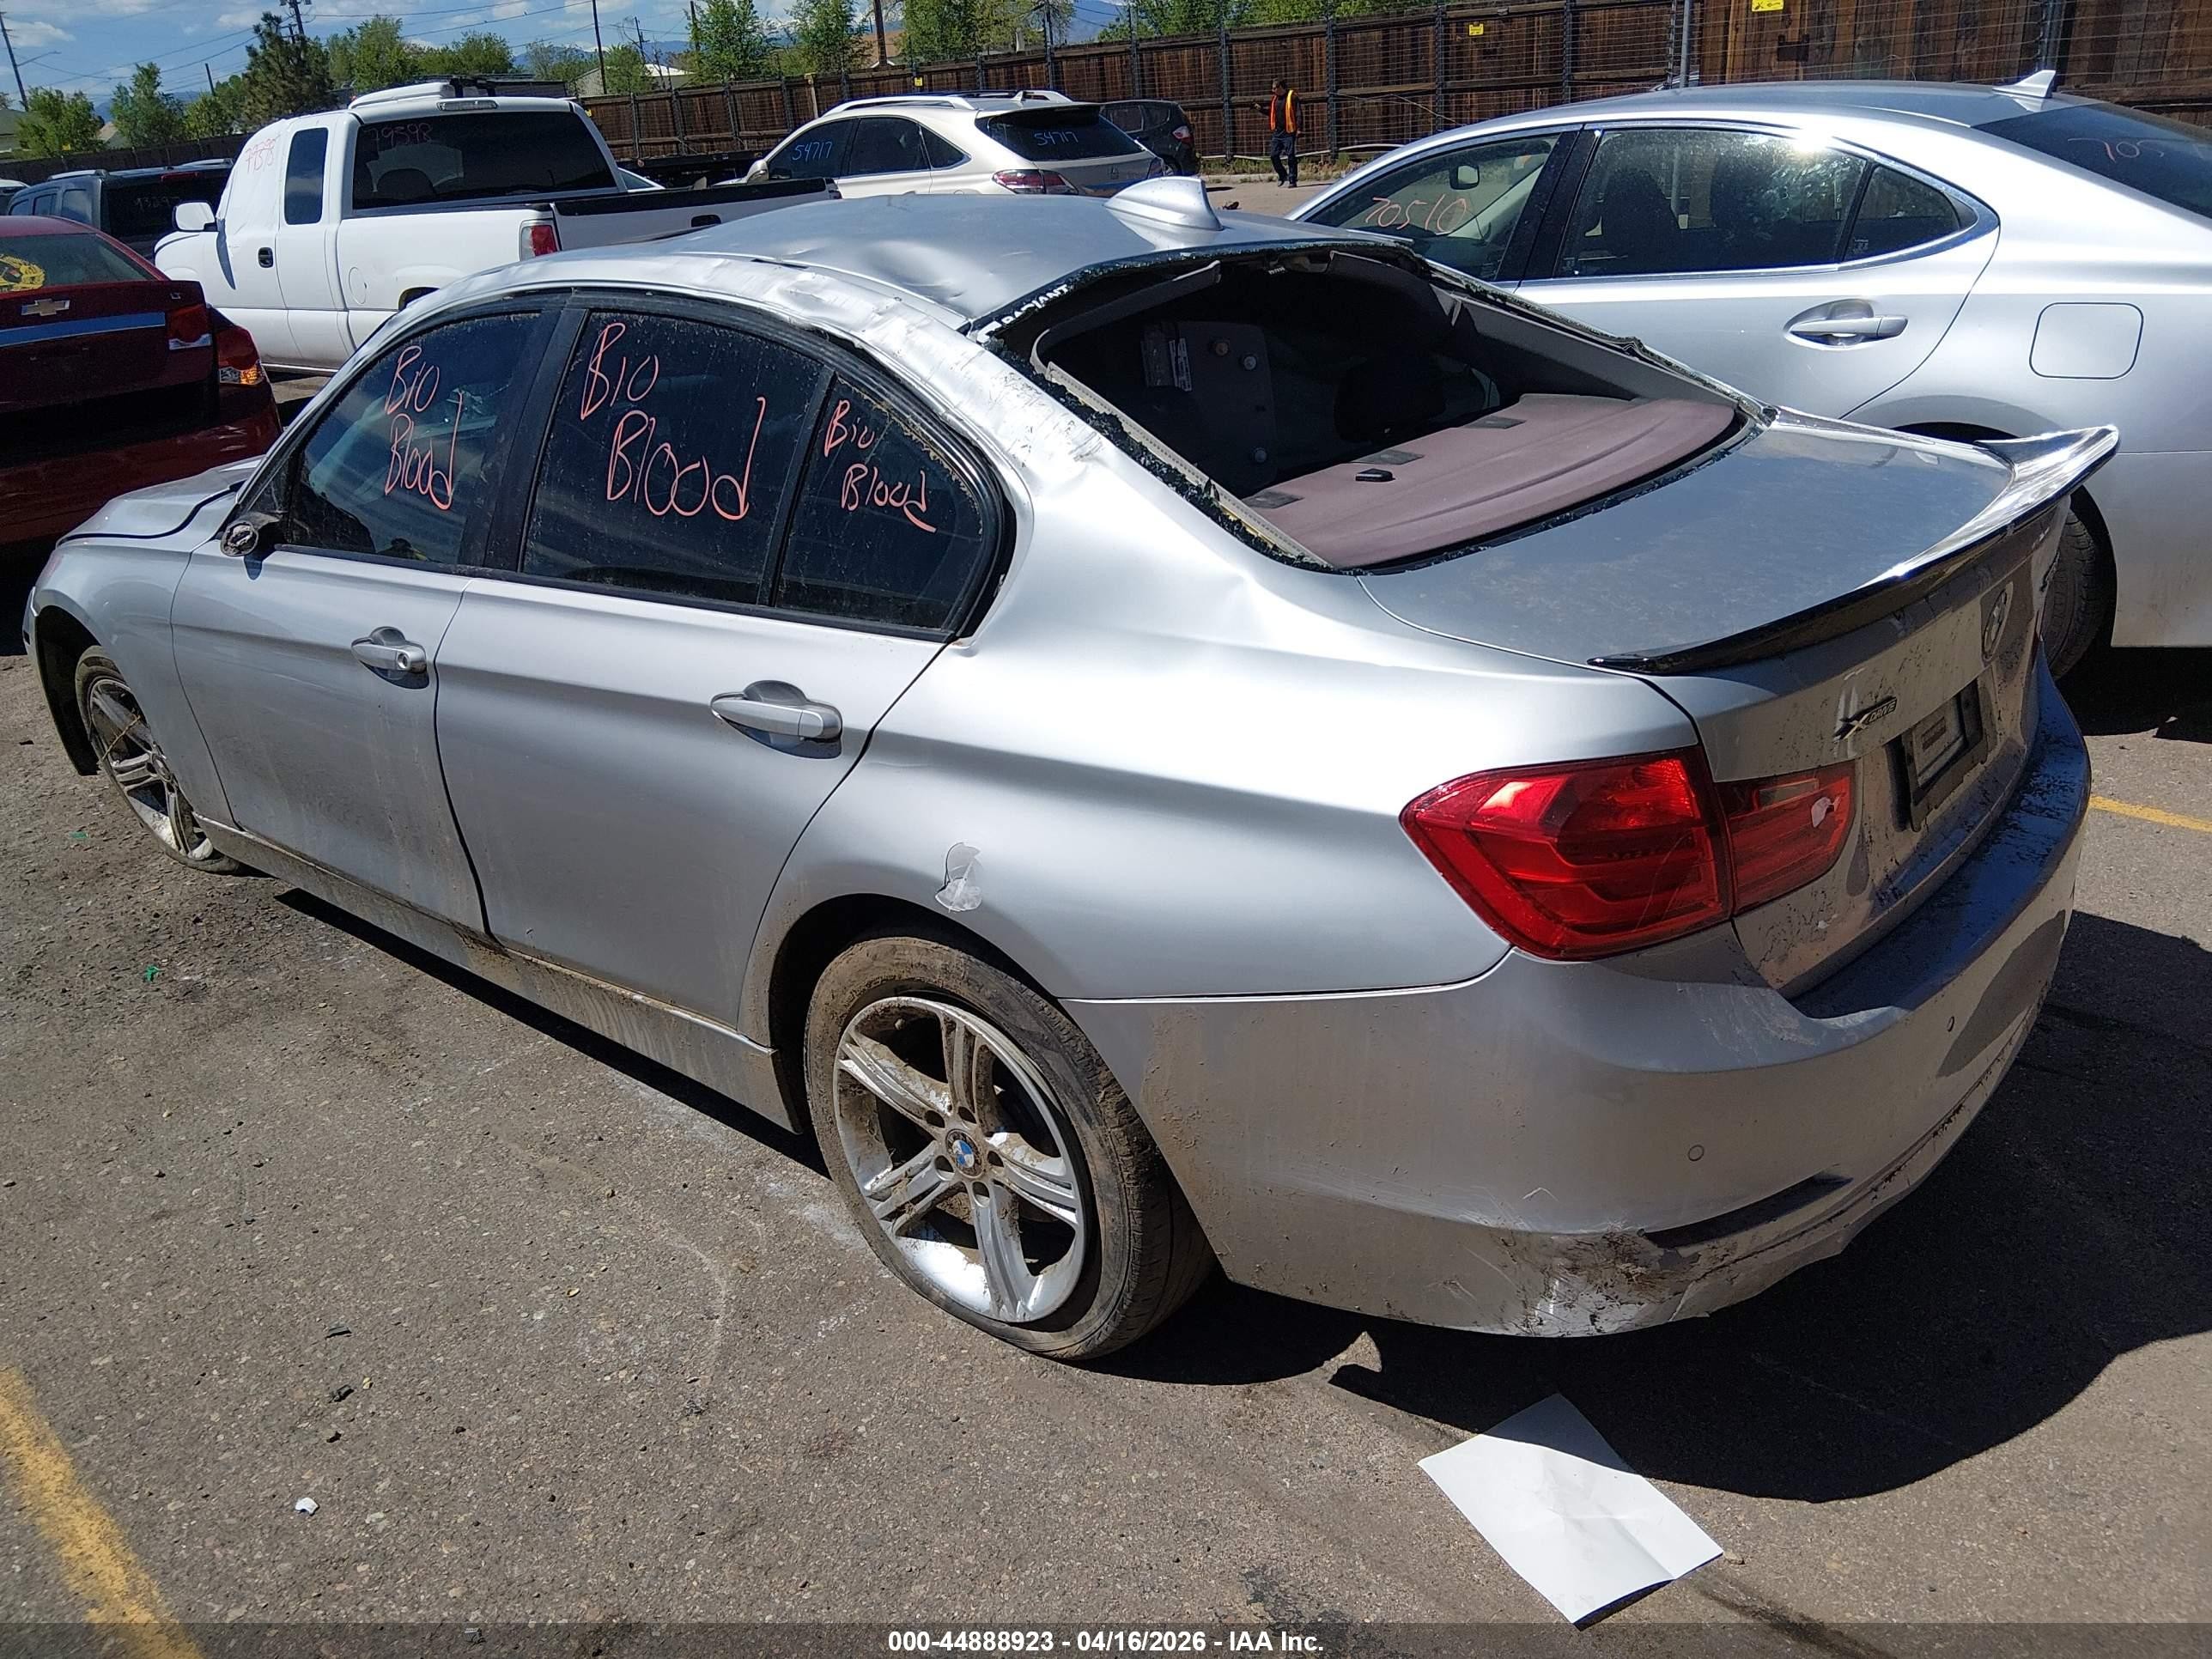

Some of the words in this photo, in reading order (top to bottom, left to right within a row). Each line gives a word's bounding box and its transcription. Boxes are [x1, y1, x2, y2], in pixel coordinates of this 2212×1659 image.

[792, 141, 833, 161] 54717
[1034, 131, 1079, 145] 54717
[1364, 193, 1467, 235] 70510
[385, 390, 463, 510] Blood
[606, 397, 767, 520] Blood
[841, 463, 937, 533] Blood
